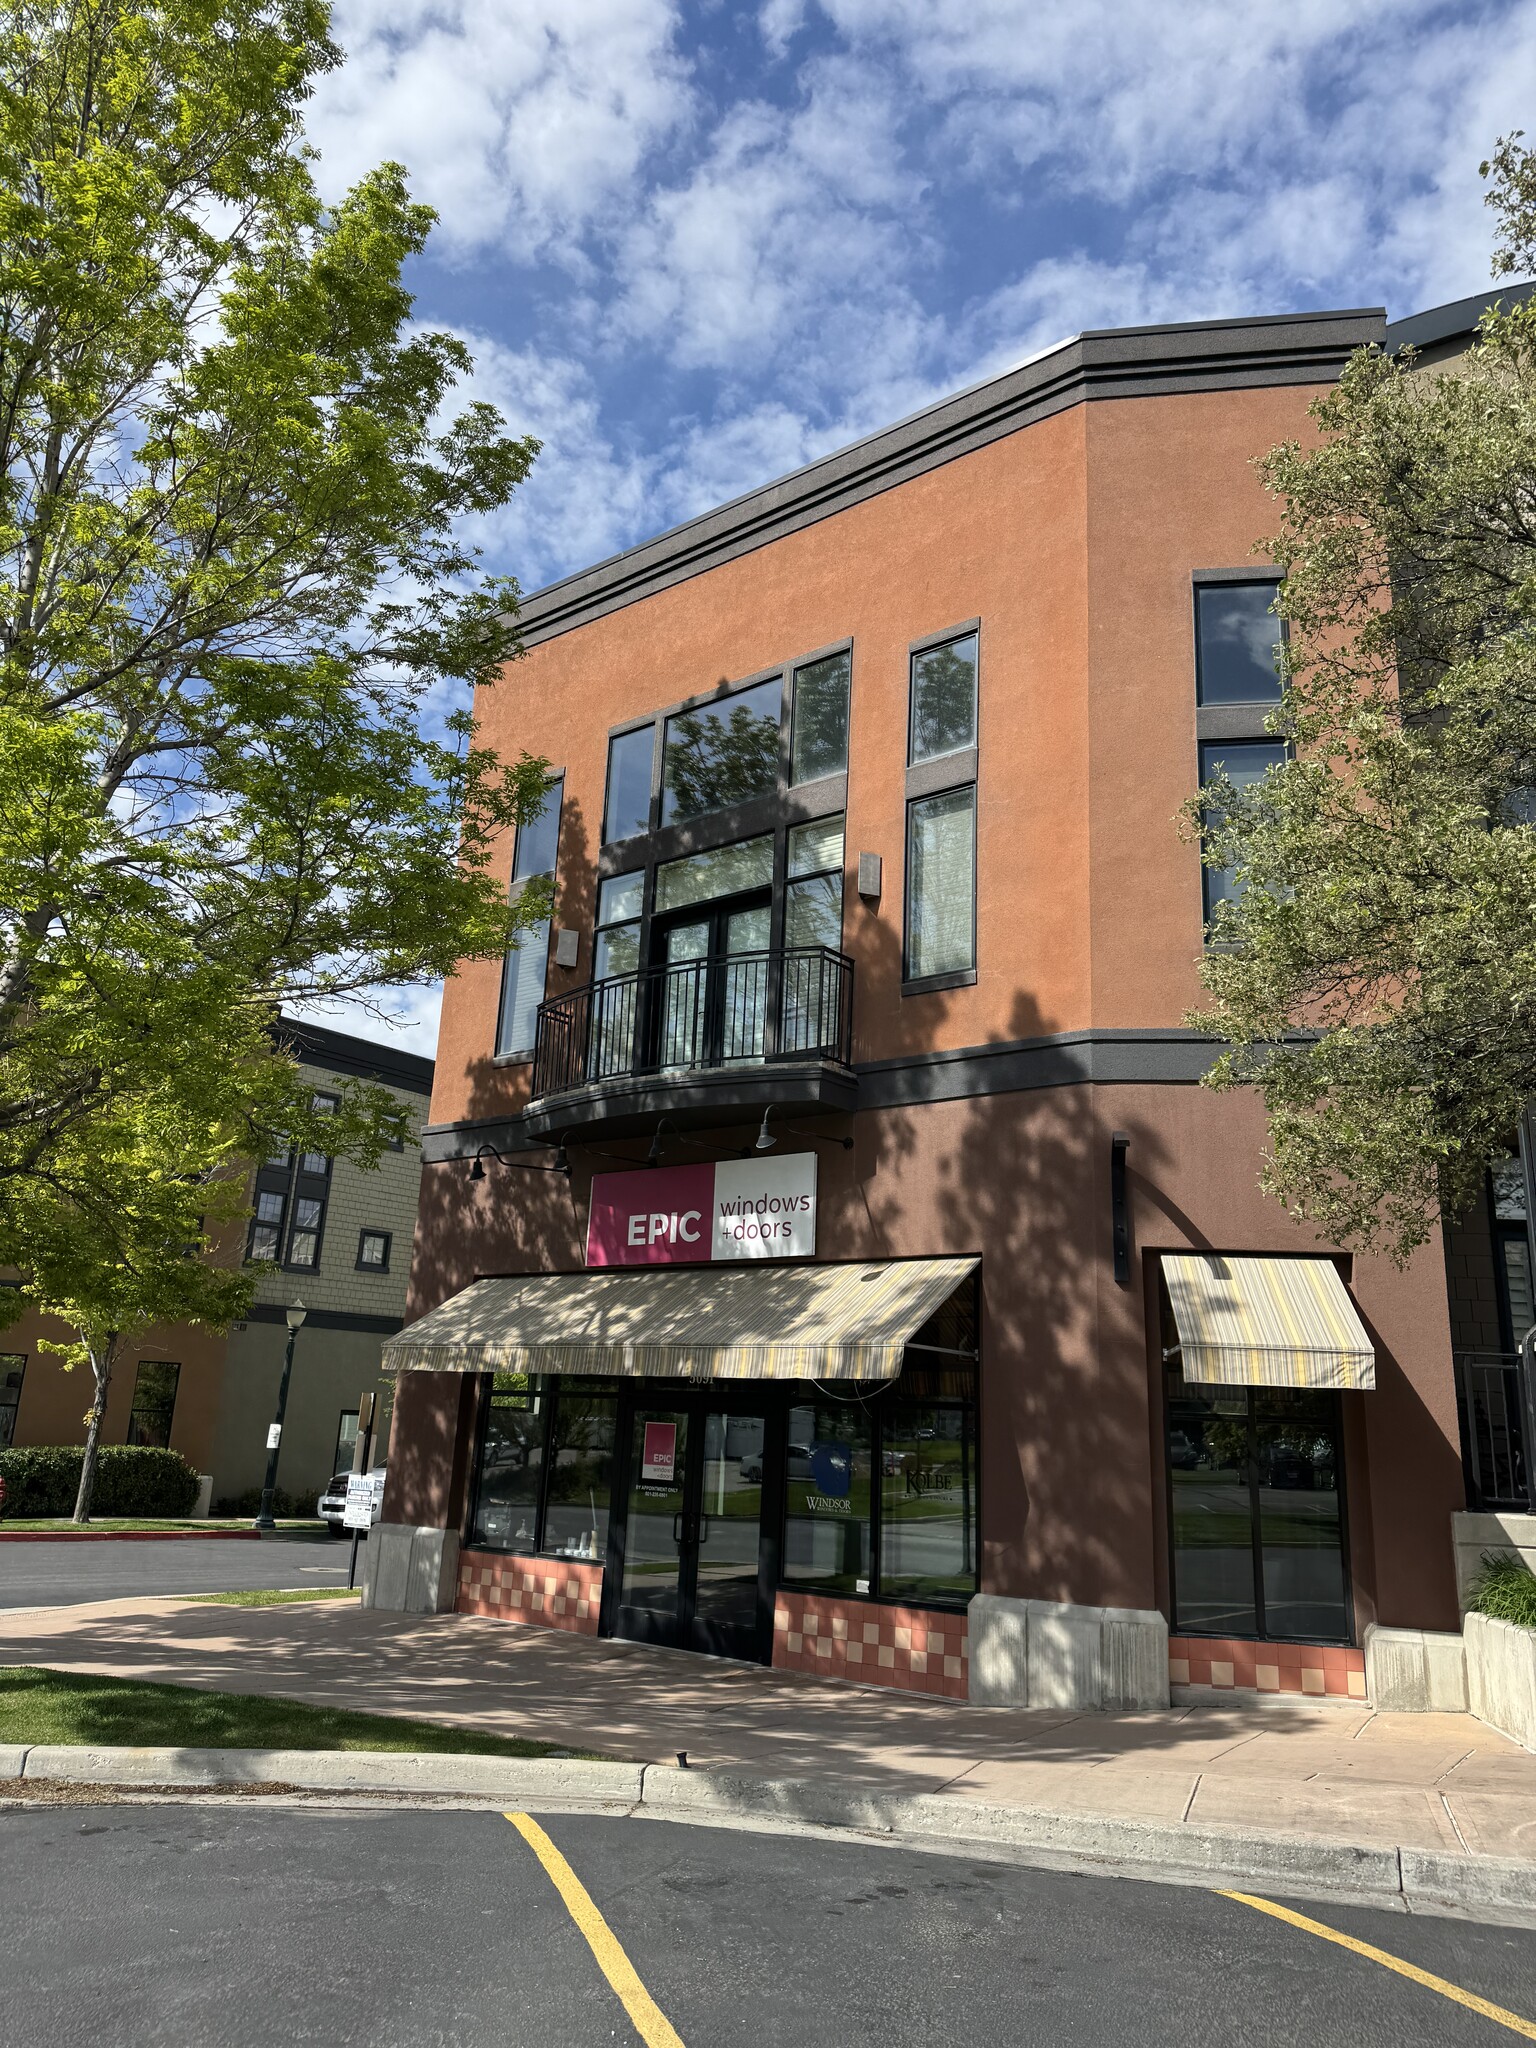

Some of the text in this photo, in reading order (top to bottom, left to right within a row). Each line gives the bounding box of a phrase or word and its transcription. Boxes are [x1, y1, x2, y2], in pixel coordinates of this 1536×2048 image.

[720, 1193, 810, 1217] windows
[627, 1210, 702, 1246] EPIC
[722, 1219, 792, 1240] +doors
[653, 1453, 672, 1463] EPIC
[653, 1466, 673, 1474] windows
[906, 1470, 952, 1494] KOLBE
[806, 1496, 851, 1510] WINDSOR
